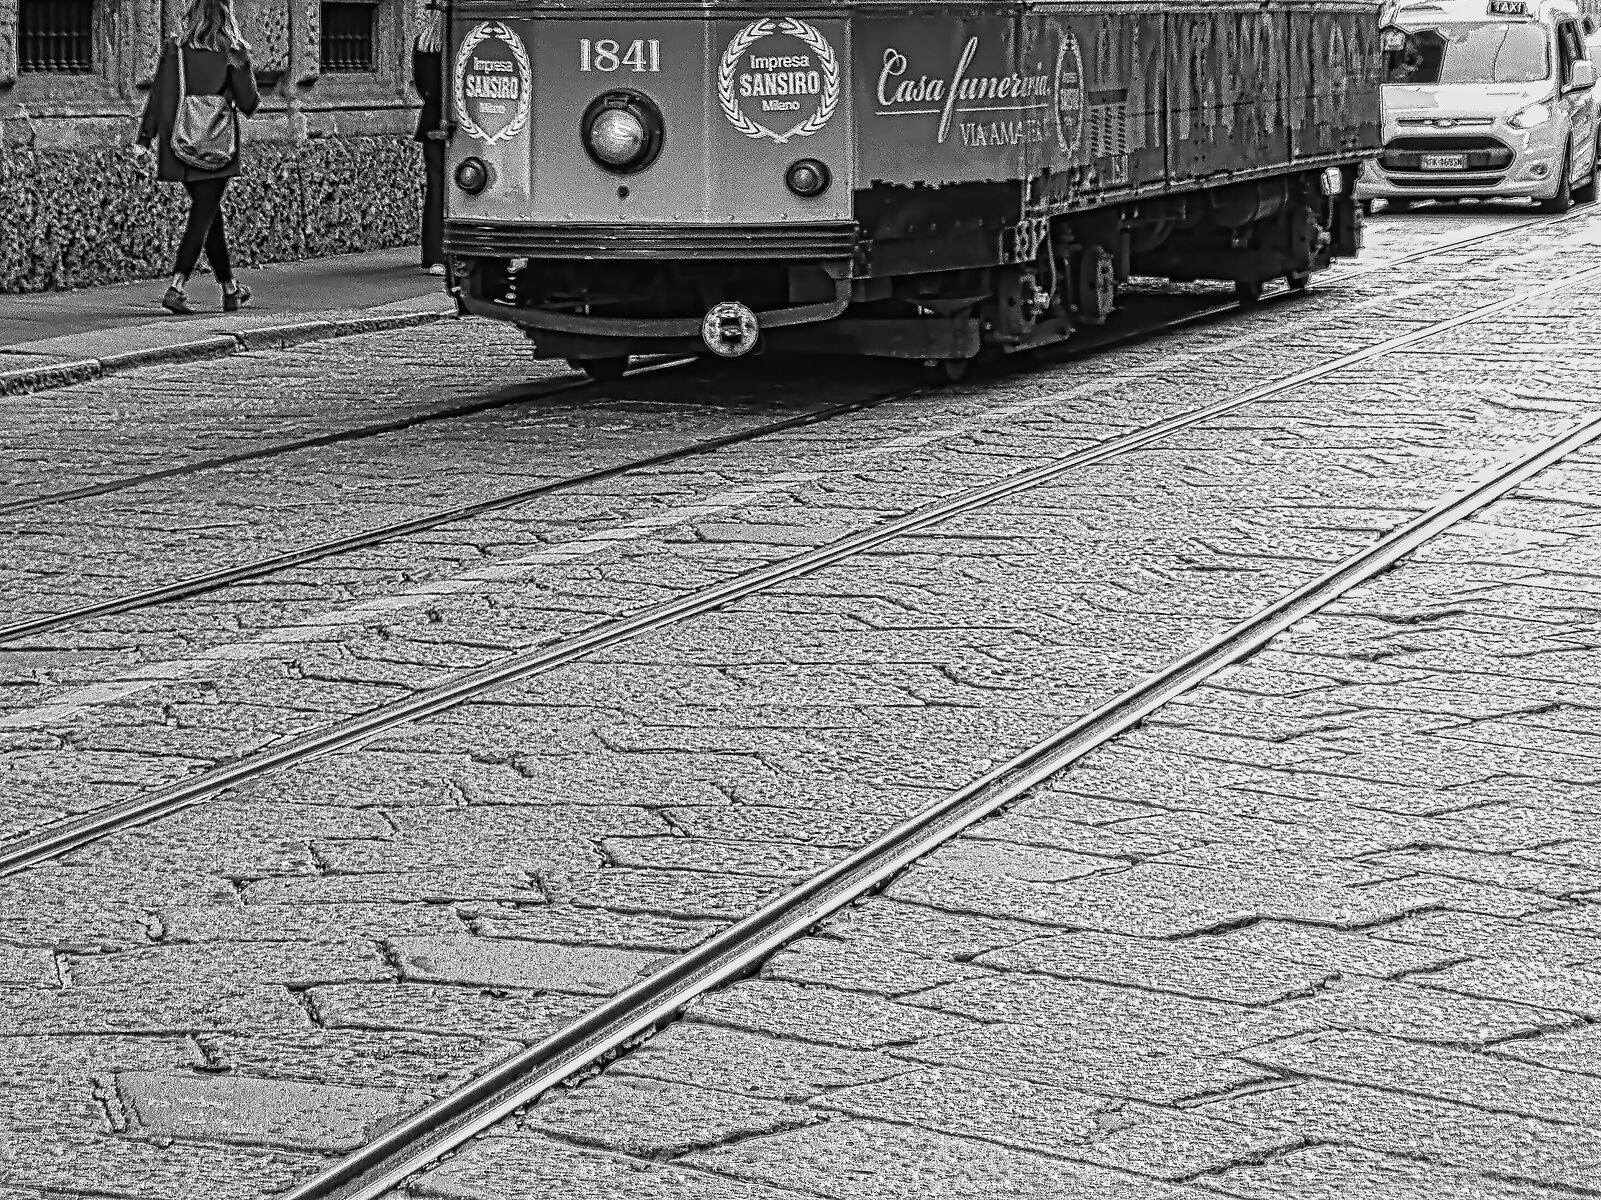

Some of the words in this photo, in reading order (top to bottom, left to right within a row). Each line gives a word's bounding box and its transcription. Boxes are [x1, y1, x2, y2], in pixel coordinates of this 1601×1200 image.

[1493, 1, 1522, 13] TAXI
[580, 38, 661, 72] 1841
[750, 54, 811, 72] Impresa
[465, 74, 520, 100] SANSIRO
[739, 70, 821, 98] SANSIRO
[877, 48, 945, 106] Casa
[762, 99, 801, 112] Milano
[960, 123, 987, 147] VIA
